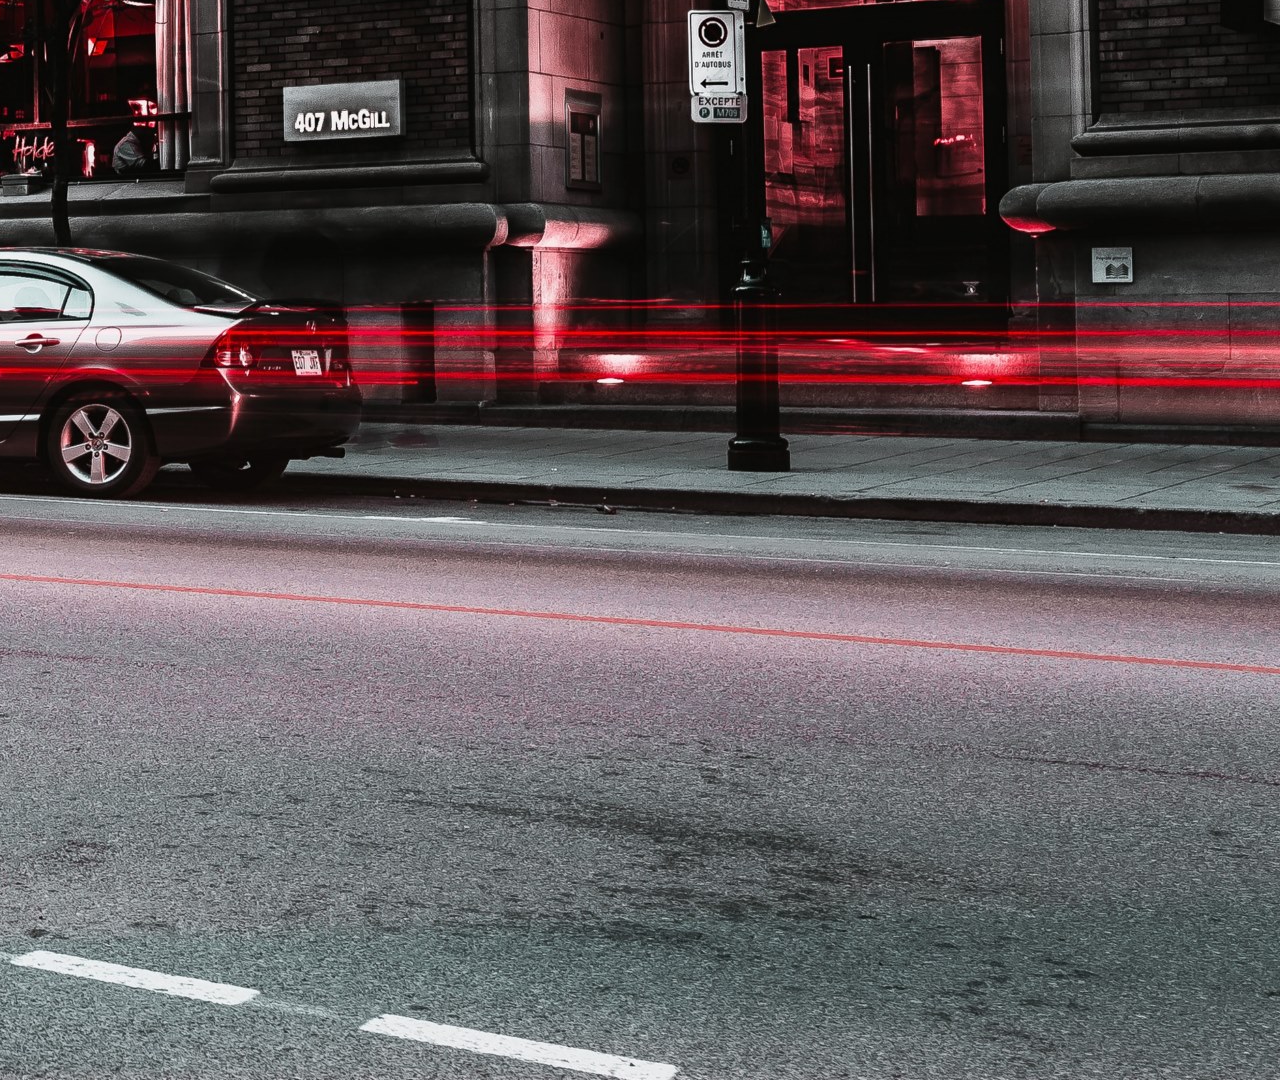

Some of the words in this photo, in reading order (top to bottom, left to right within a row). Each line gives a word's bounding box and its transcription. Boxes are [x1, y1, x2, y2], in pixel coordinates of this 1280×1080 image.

[701, 50, 724, 59] ARRÊT
[694, 60, 732, 69] D'AUTOBUS
[716, 109, 738, 117] M709
[294, 112, 325, 133] 407
[12, 135, 55, 169] Holde
